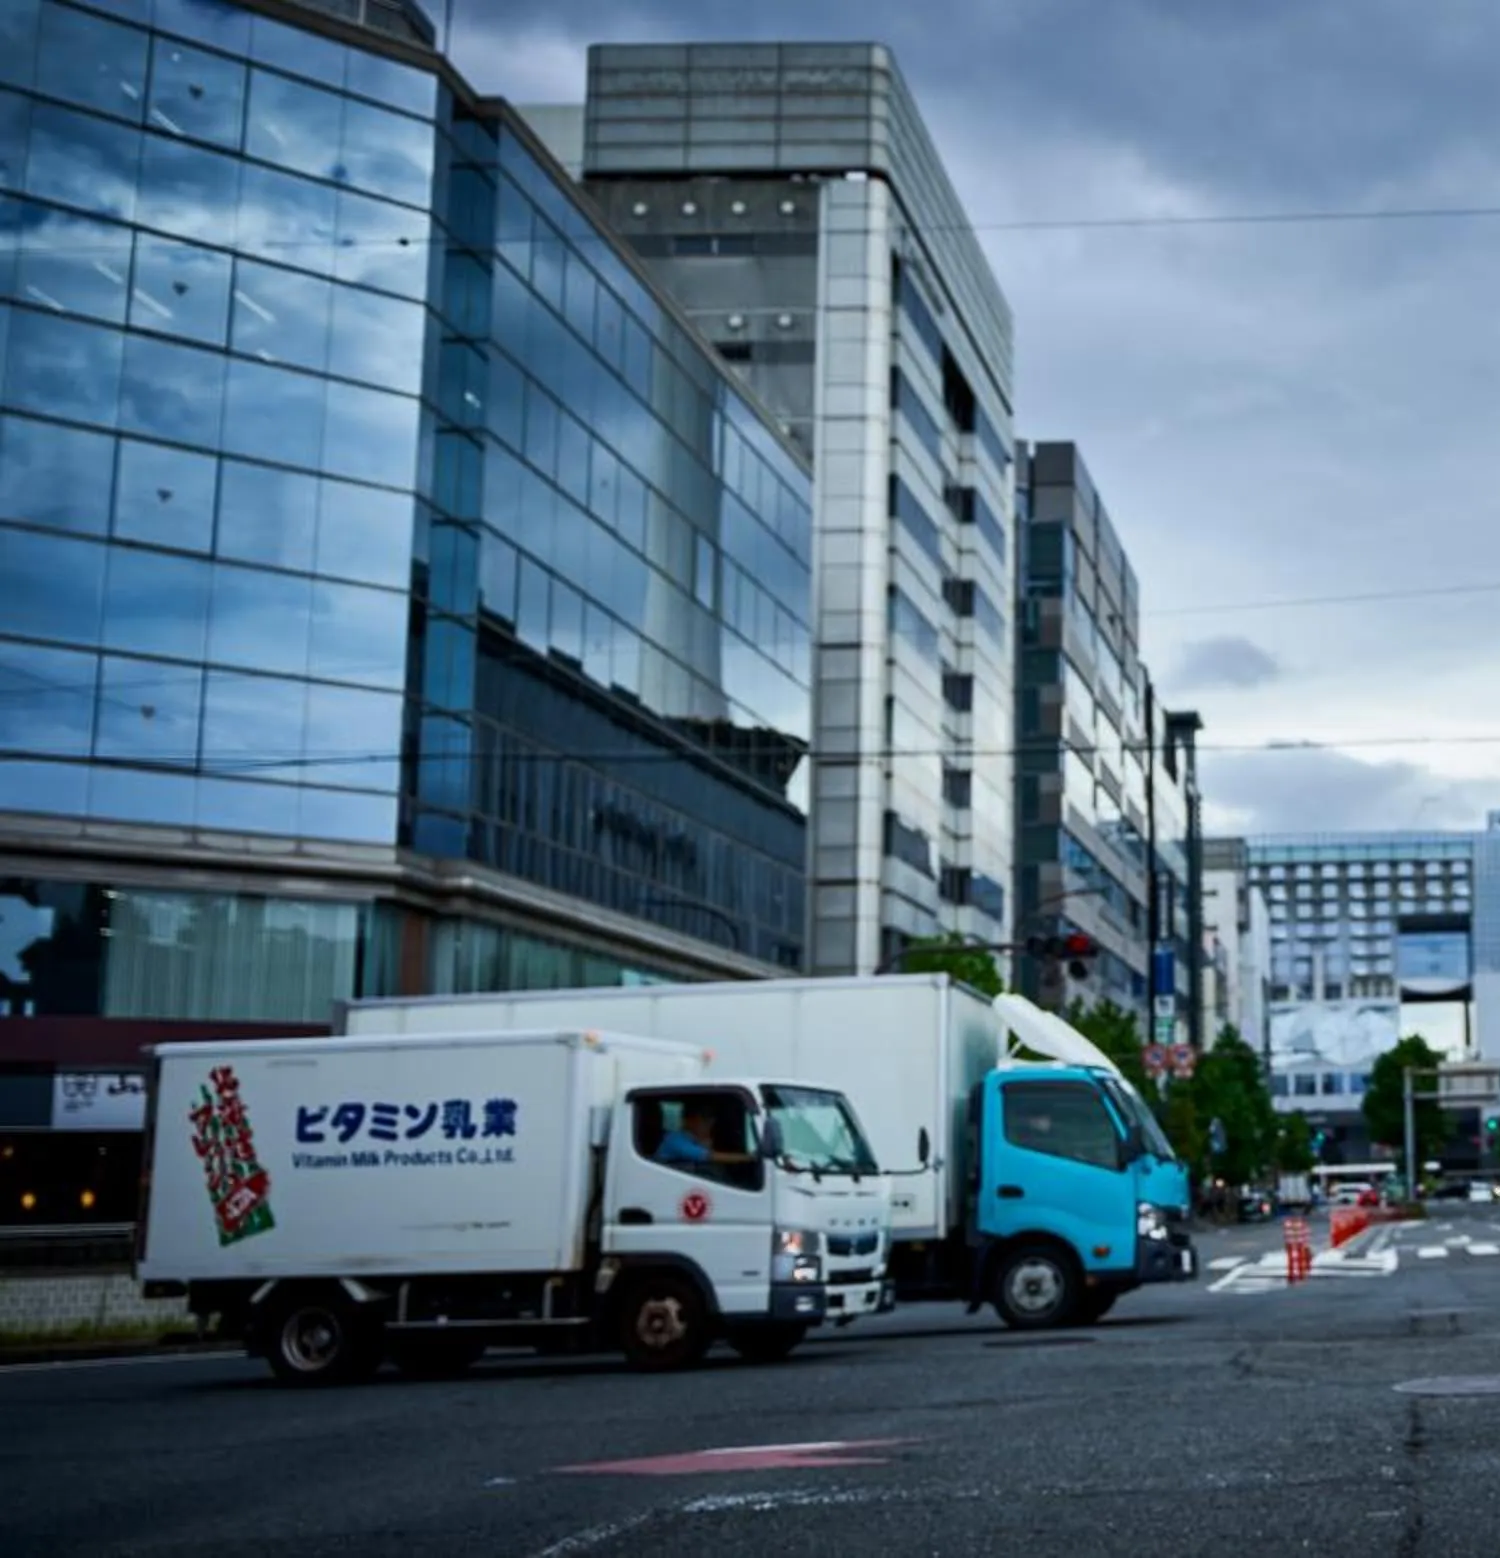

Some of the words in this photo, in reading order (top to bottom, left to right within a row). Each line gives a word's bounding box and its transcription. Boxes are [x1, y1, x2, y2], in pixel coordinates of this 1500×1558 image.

[296, 1098, 517, 1143] ビタミン乳業
[292, 1152, 347, 1168] Vitamin
[351, 1151, 380, 1167] Milk
[384, 1149, 453, 1166] Products
